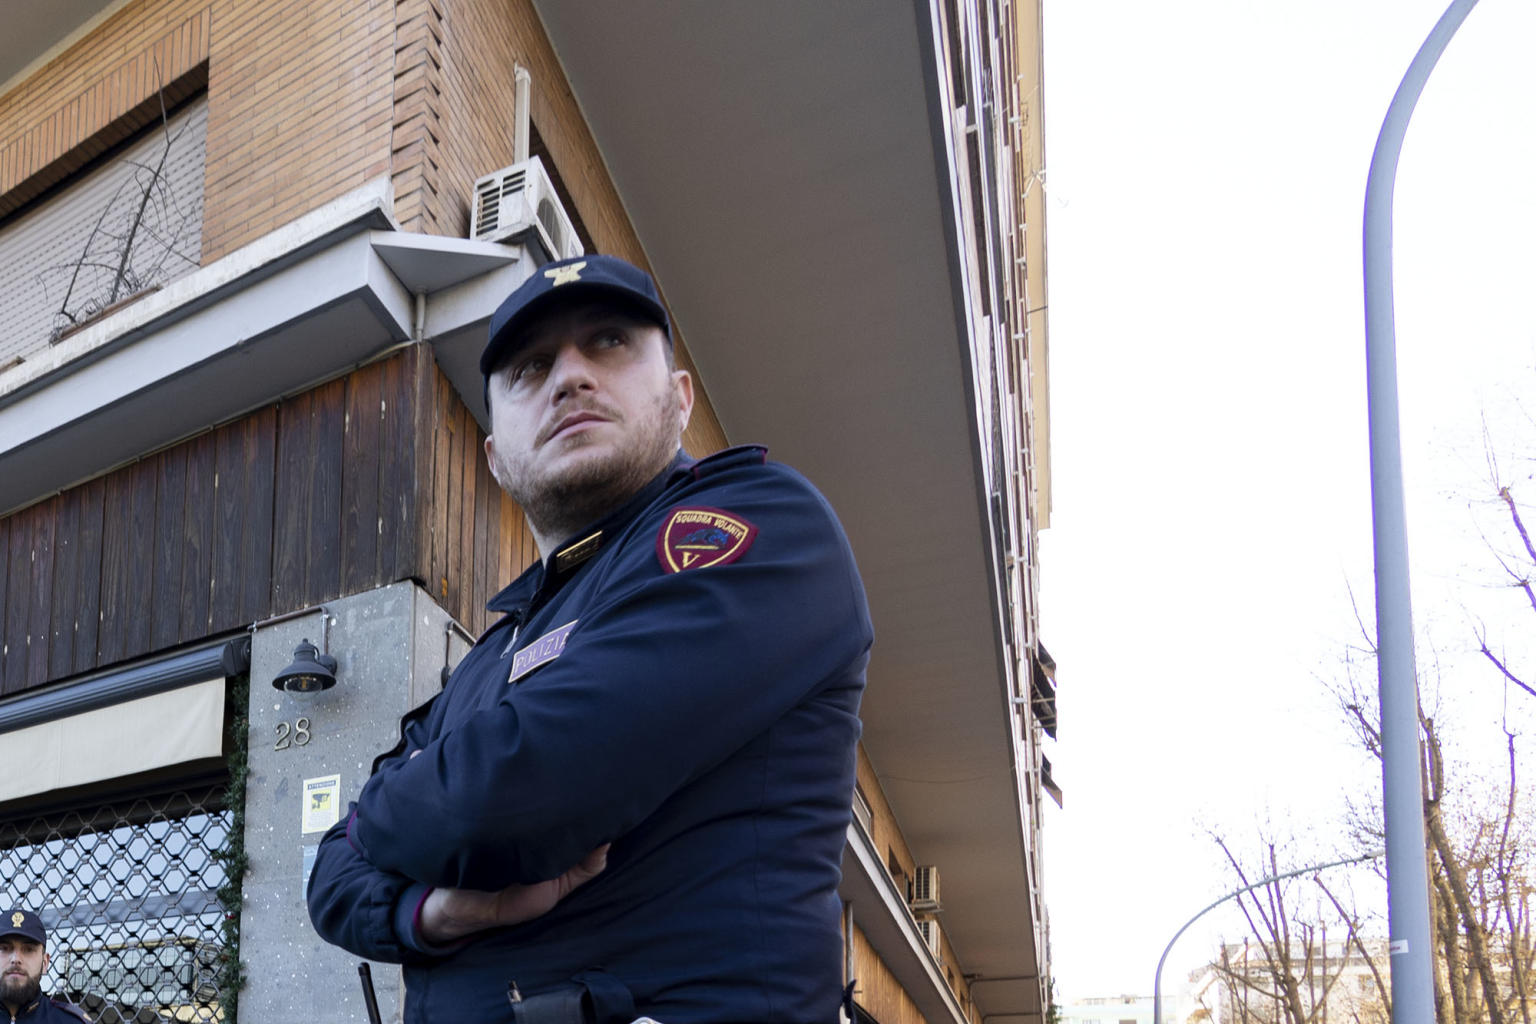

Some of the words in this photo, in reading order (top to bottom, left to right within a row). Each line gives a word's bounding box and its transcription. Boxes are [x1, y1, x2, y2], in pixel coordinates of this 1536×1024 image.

[675, 513, 712, 524] SQUADRA
[714, 517, 744, 540] VOLANTE
[274, 717, 312, 751] 28
